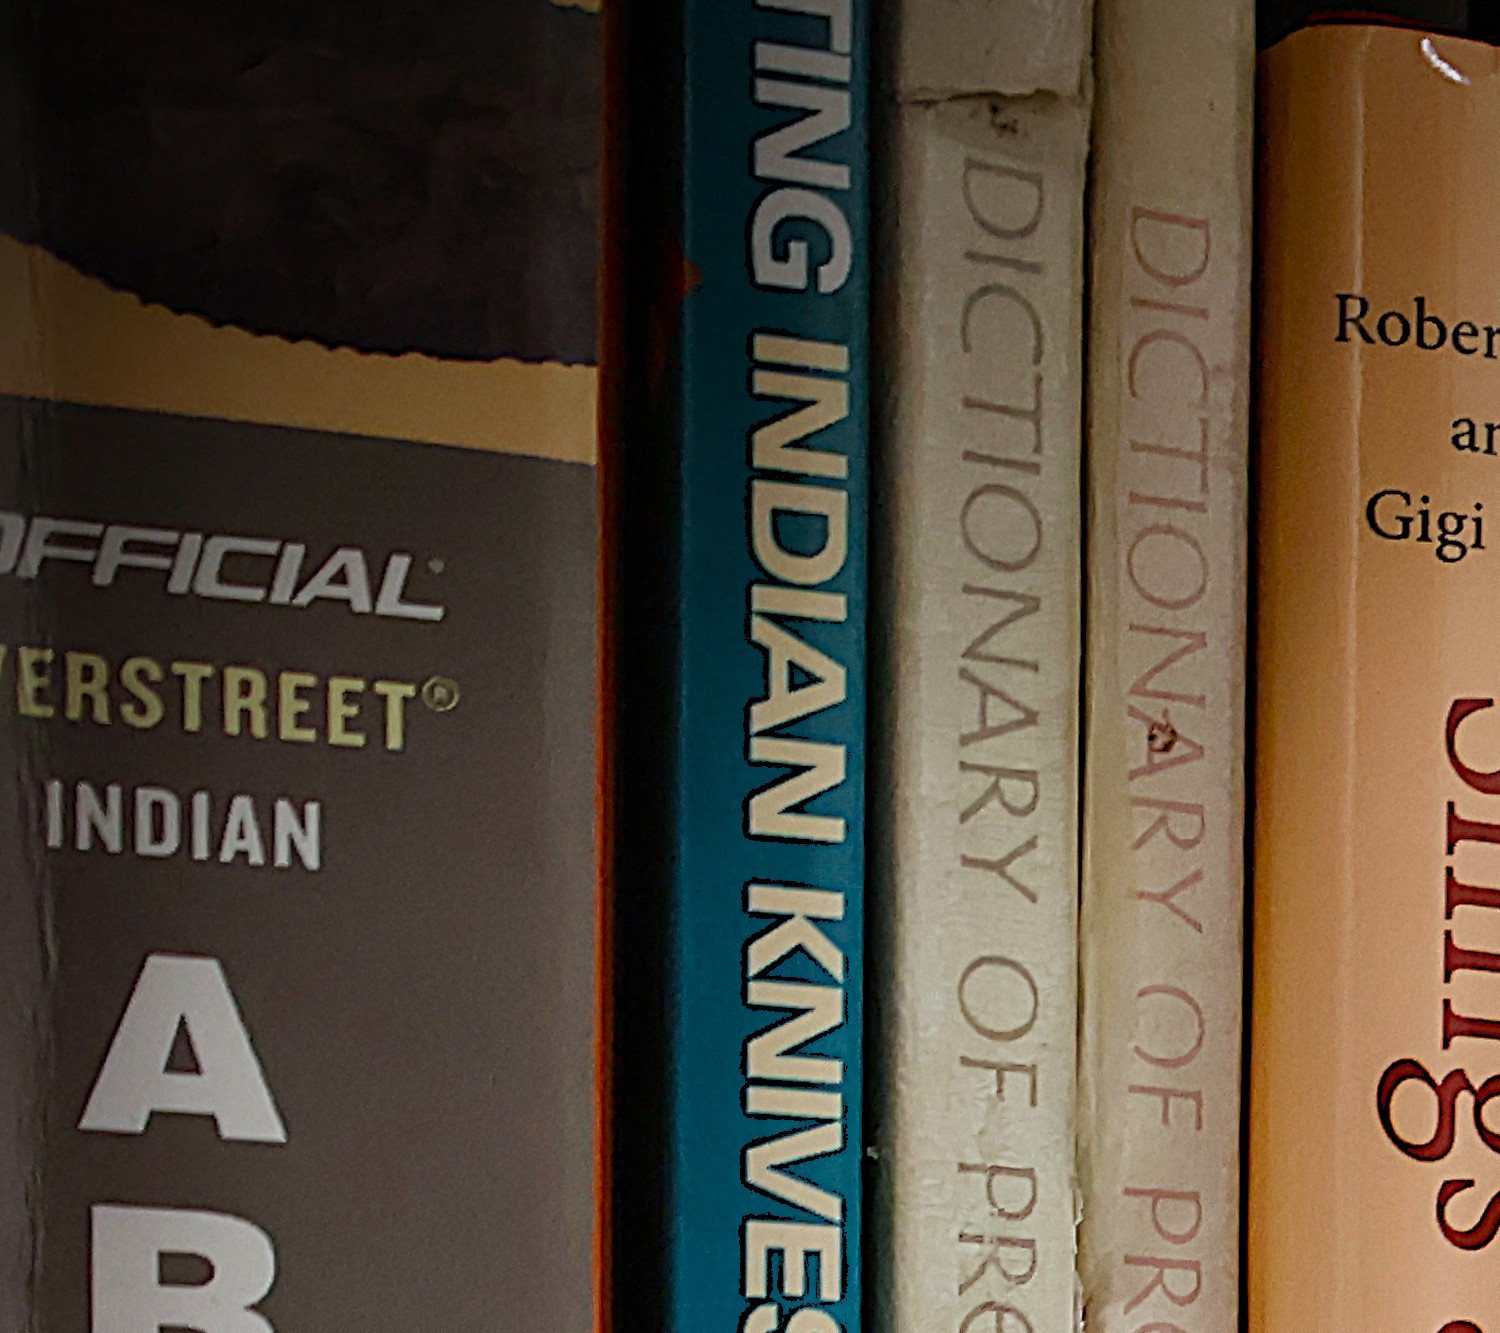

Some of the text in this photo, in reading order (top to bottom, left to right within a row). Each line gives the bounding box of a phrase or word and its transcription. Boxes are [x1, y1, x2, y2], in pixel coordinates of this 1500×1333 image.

[748, 332, 852, 844] INDIAN
[958, 160, 1047, 905] DICTIONARY
[1125, 205, 1211, 934] DICTIONARY
[1365, 489, 1486, 563] Gigi
[0, 644, 418, 751] ERSTREET
[44, 779, 322, 871] INDIAN
[955, 955, 1040, 1107] OF
[1127, 983, 1206, 1131] OF
